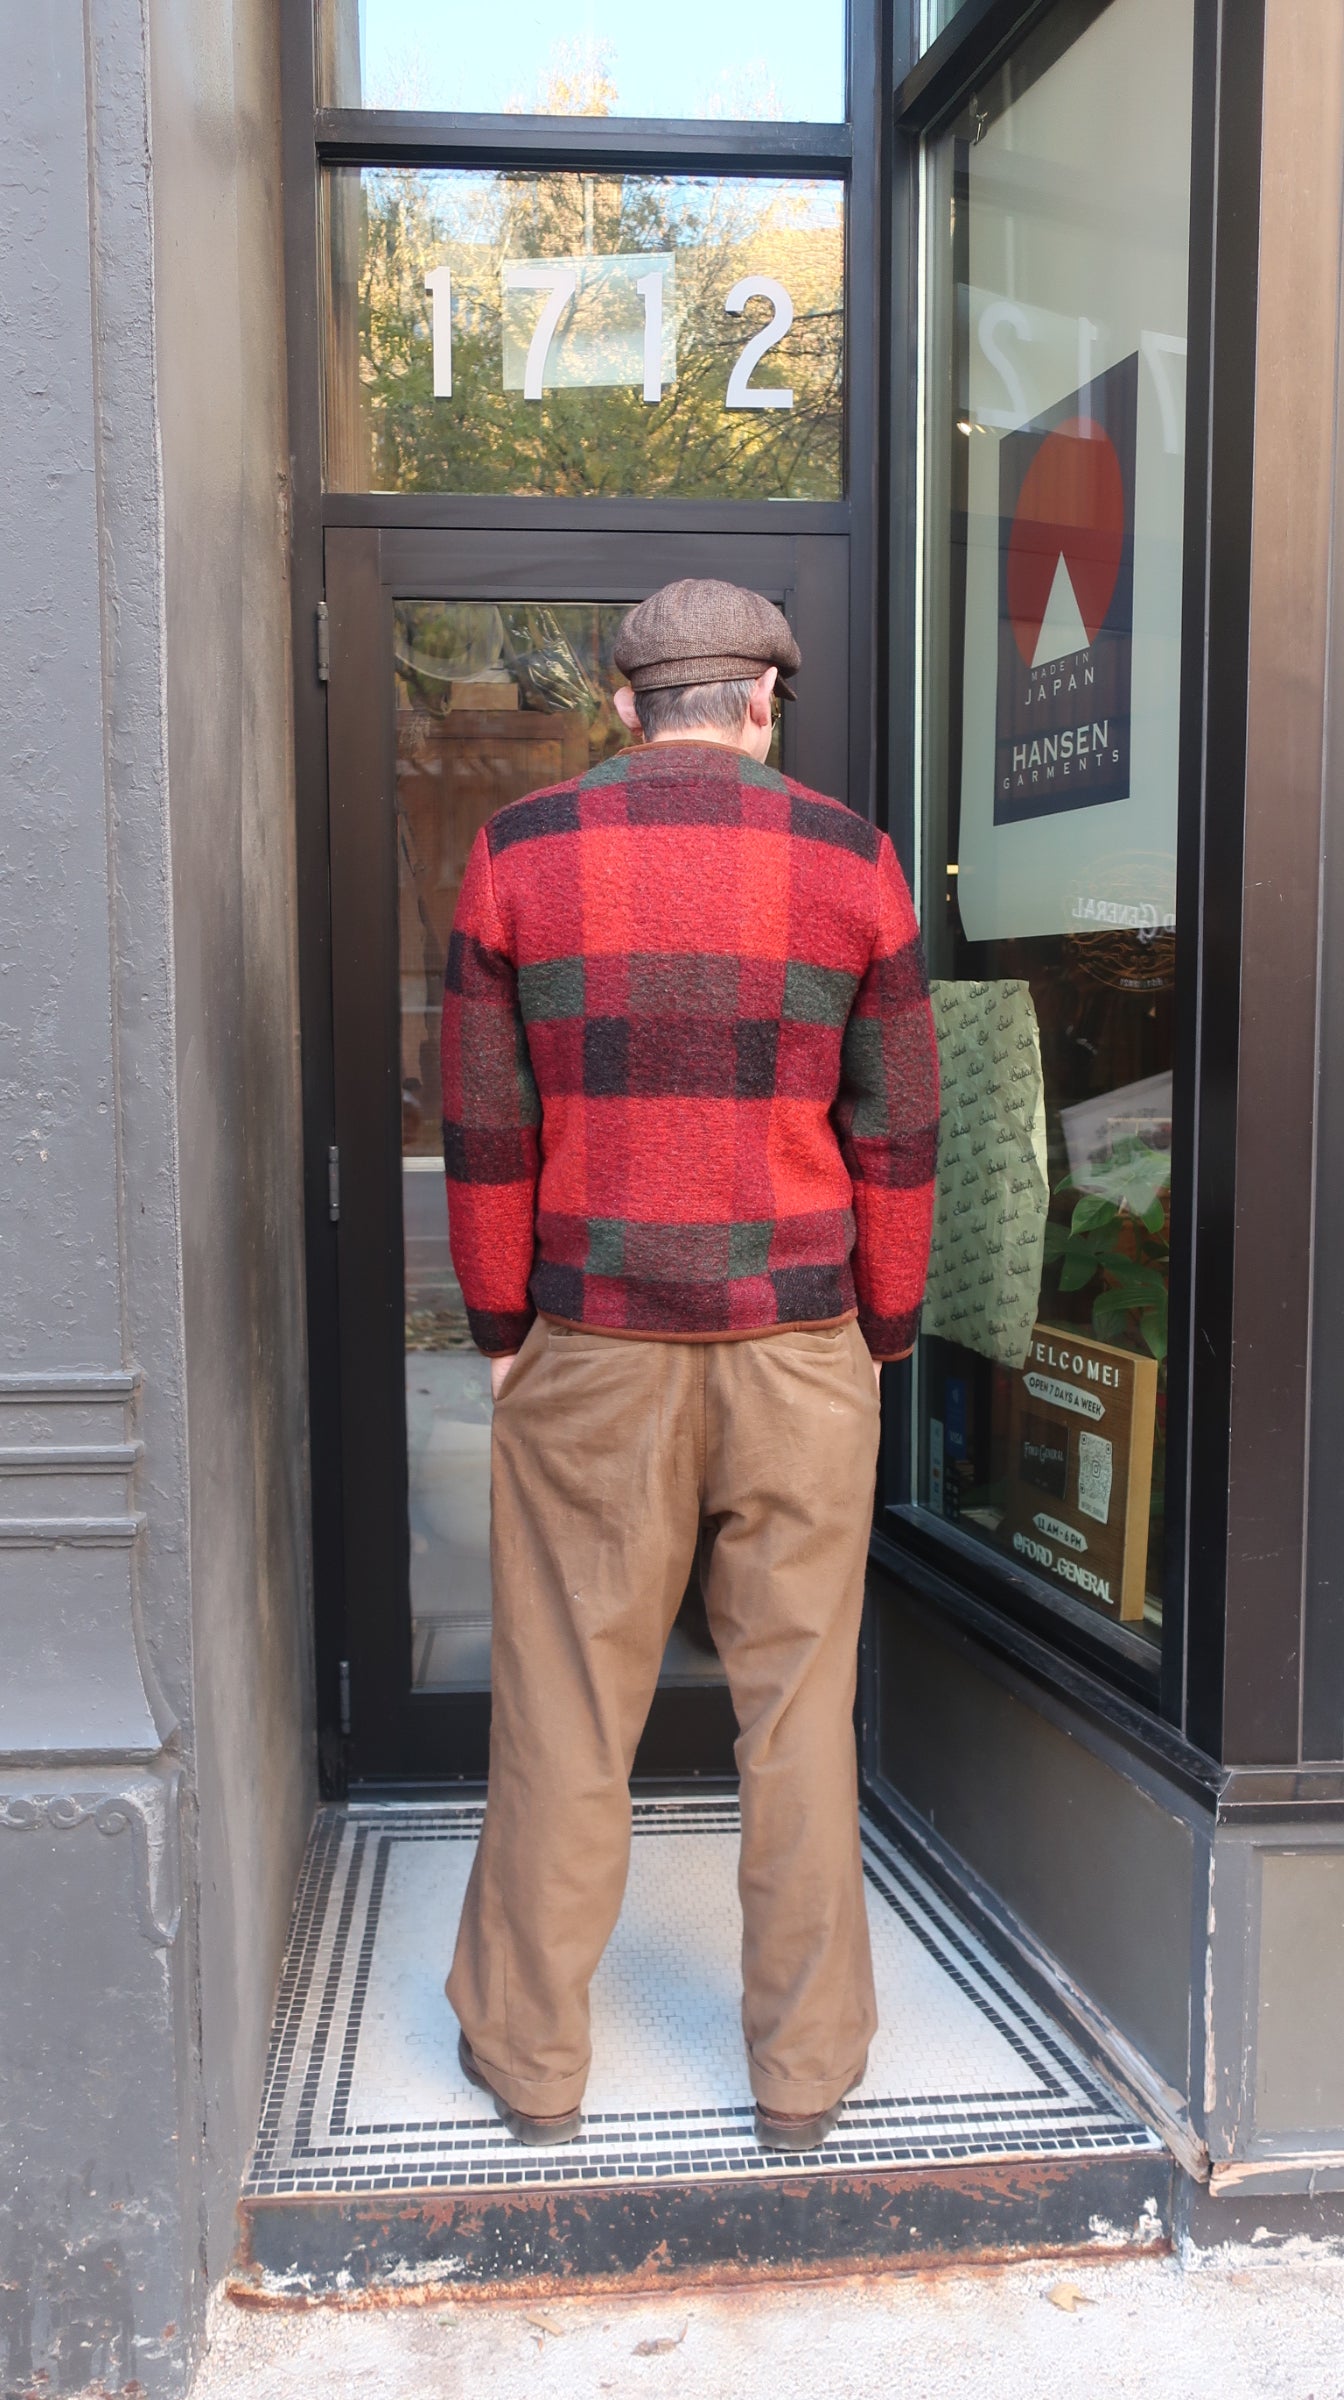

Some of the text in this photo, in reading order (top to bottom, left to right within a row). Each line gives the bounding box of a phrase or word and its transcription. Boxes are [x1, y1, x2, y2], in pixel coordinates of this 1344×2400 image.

[424, 265, 794, 409] 1712
[1024, 666, 1095, 706] JAPAN
[1031, 652, 1090, 682] MADE IN
[1013, 719, 1109, 772] HANSEN
[1003, 749, 1120, 790] GARMENTS
[1028, 1340, 1119, 1388] ELCOME!
[1029, 1376, 1102, 1417] OPEN 7 DAYS A WEEK
[1037, 1516, 1046, 1530] 11
[1046, 1522, 1060, 1537] AM
[1064, 1530, 1070, 1543] 6
[1070, 1533, 1082, 1549] PM
